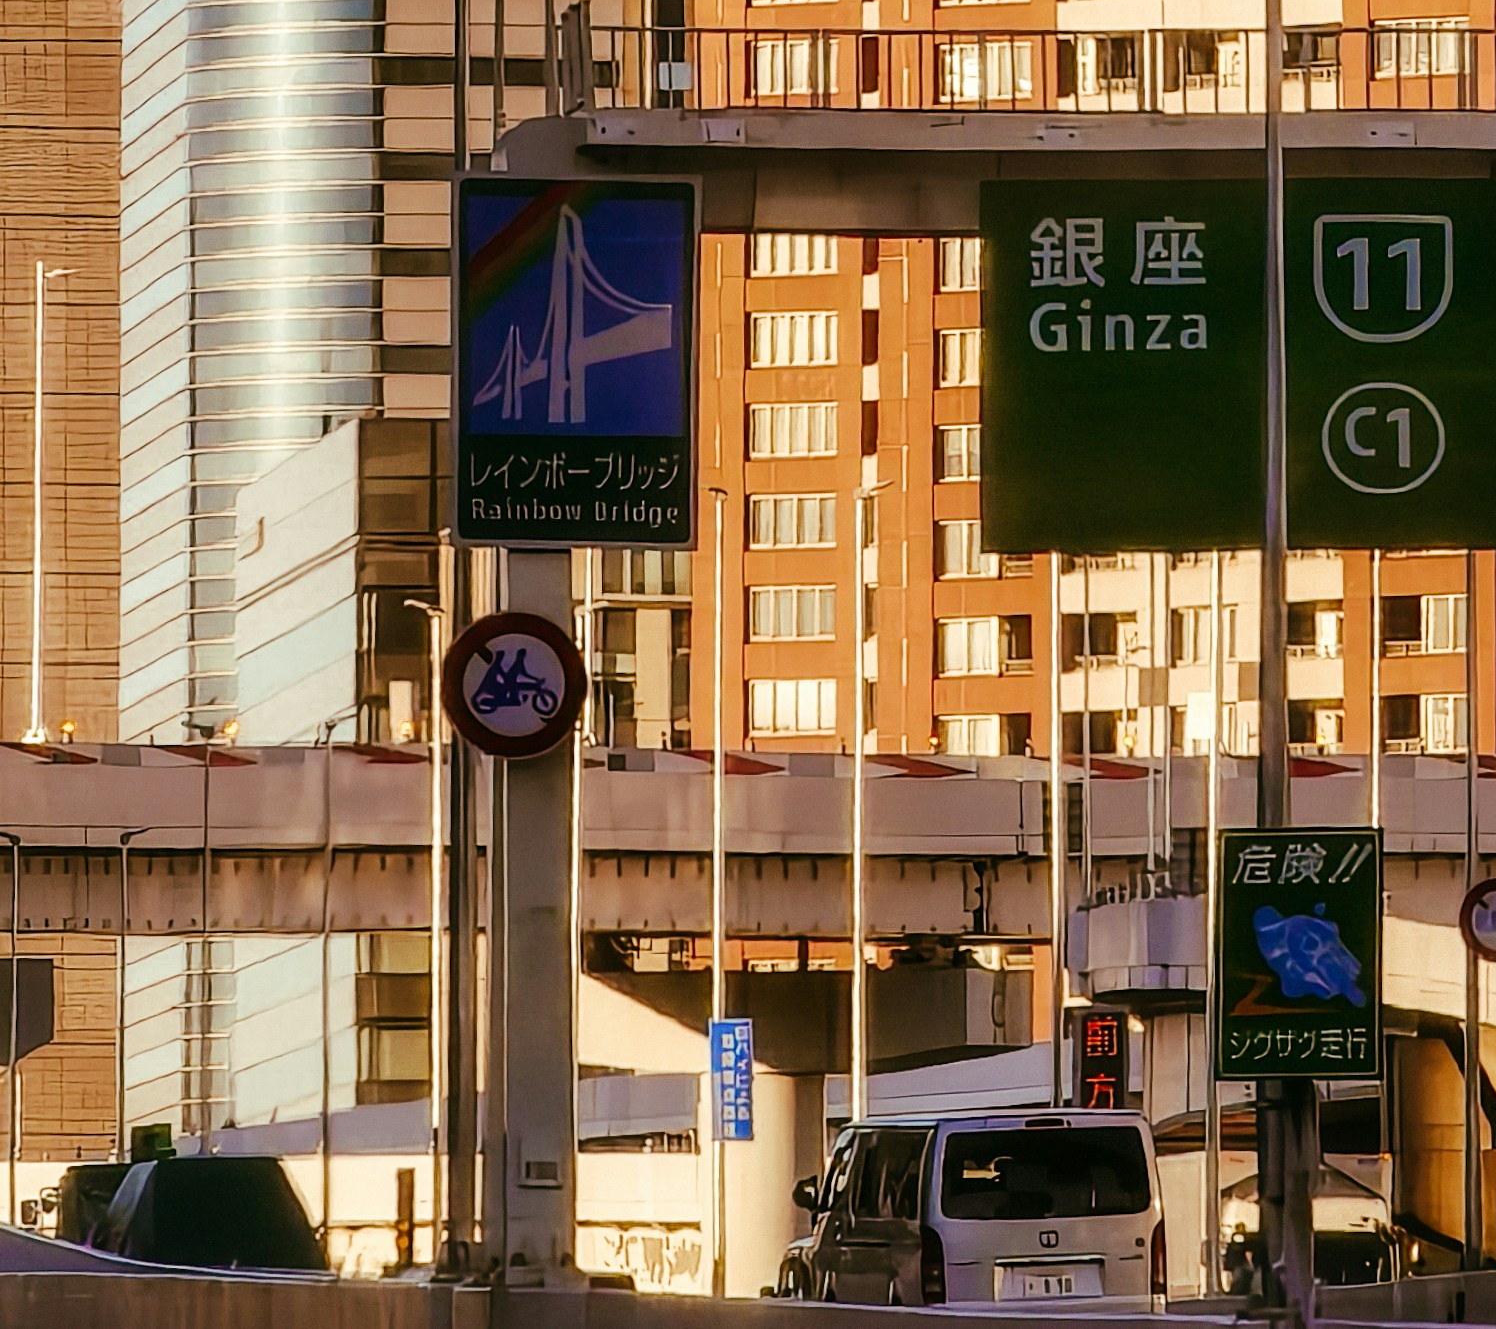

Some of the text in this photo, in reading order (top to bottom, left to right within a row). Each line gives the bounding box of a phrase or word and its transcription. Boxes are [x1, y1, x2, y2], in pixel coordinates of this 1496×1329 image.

[1030, 215, 1207, 287] 銀座
[1336, 236, 1422, 311] 11
[1029, 298, 1208, 352] Ginza
[1344, 406, 1411, 469] C1
[472, 497, 581, 521] Rainbow
